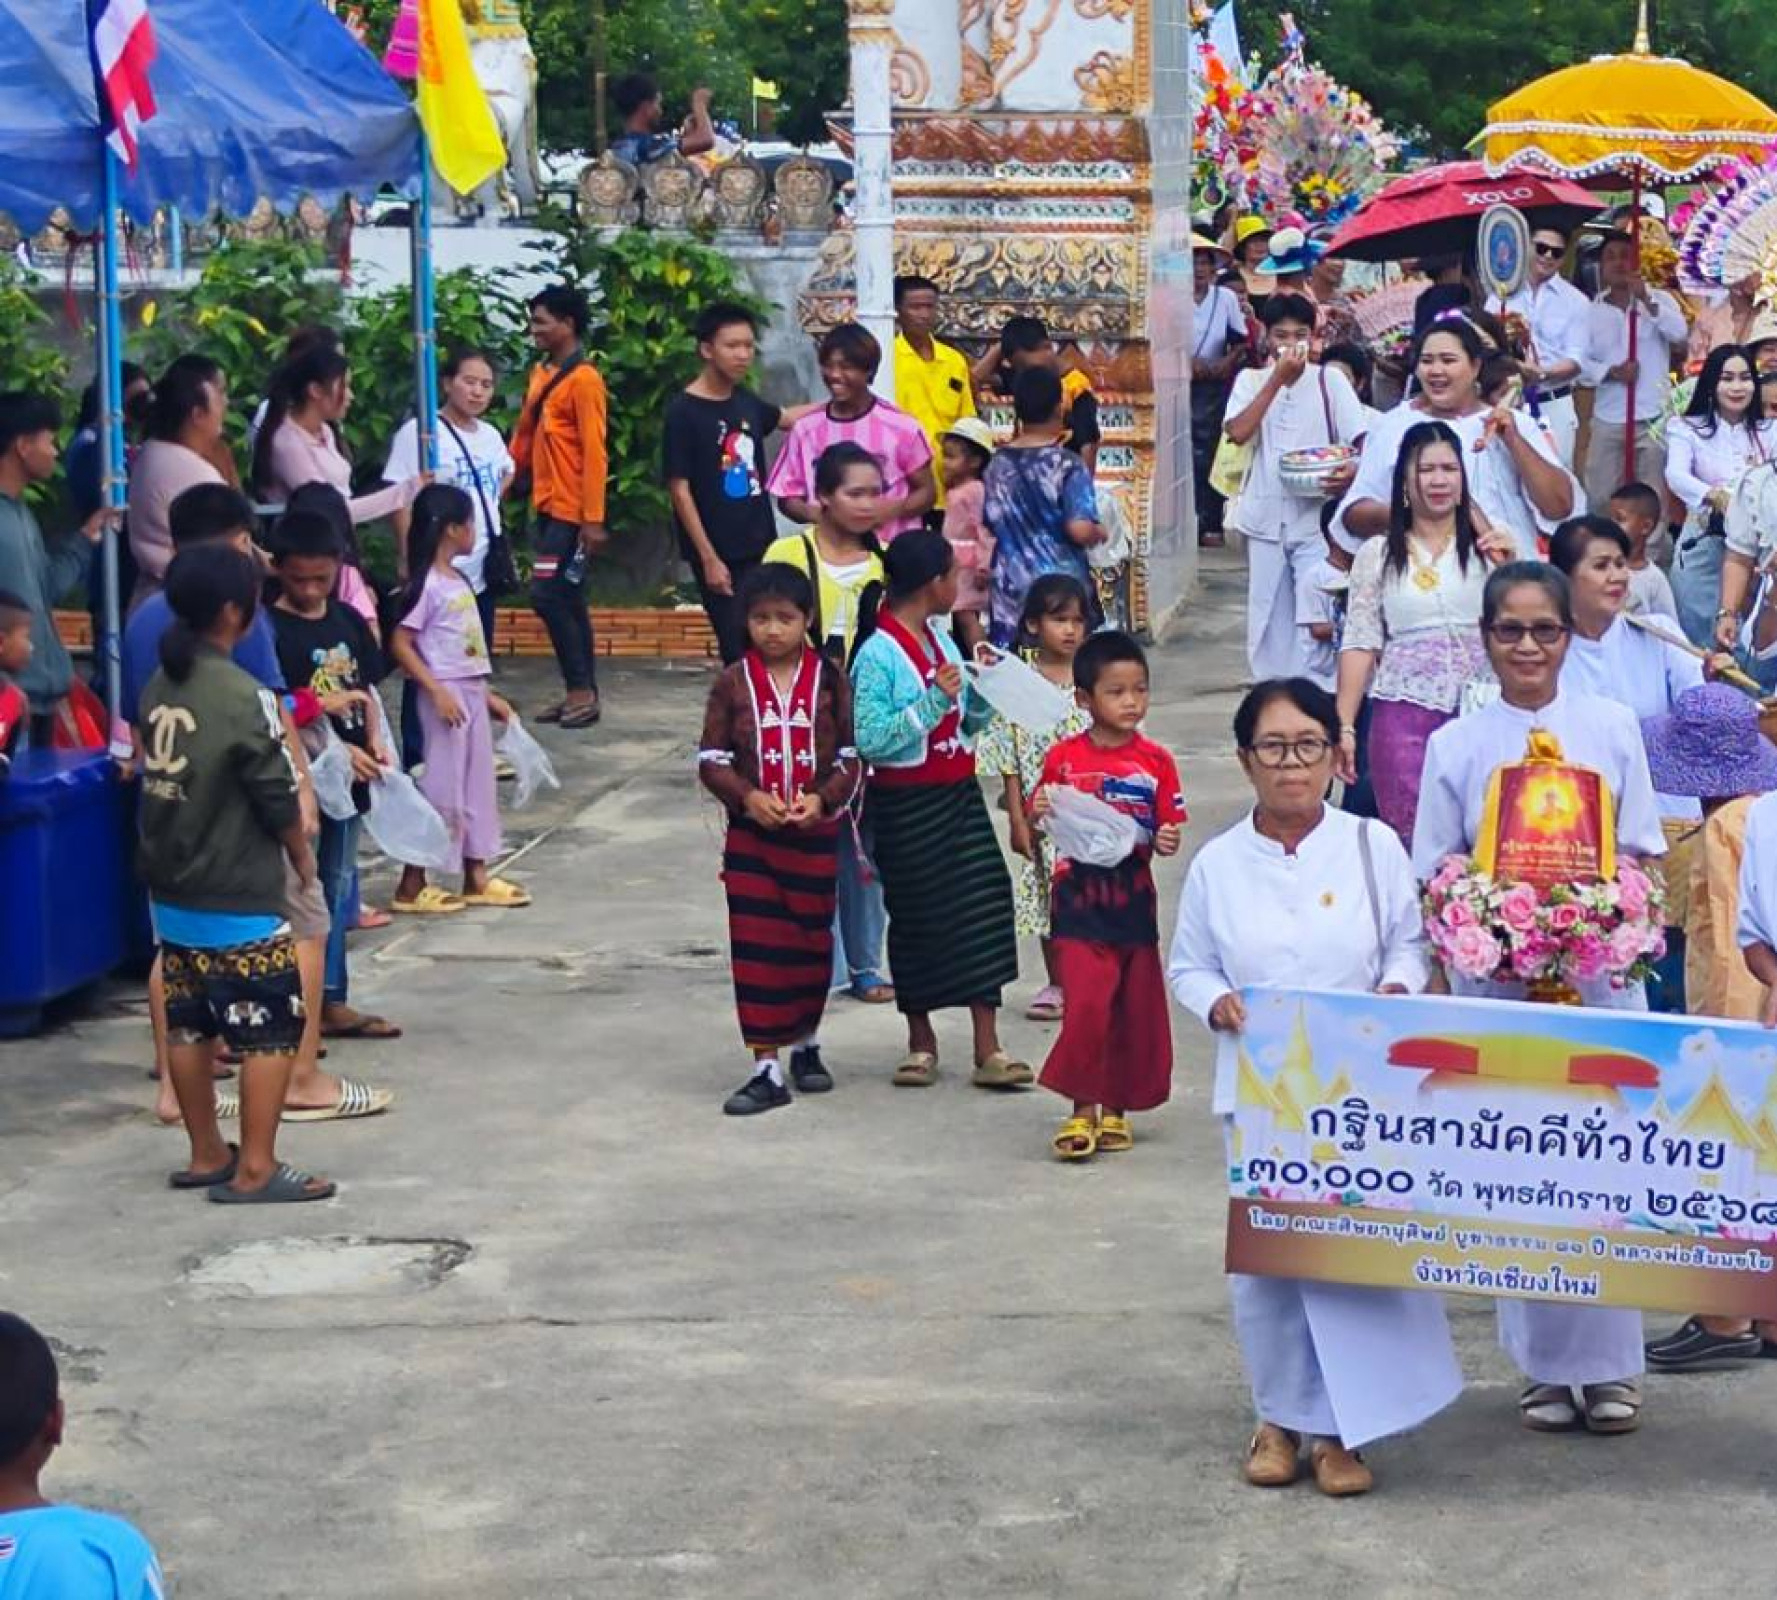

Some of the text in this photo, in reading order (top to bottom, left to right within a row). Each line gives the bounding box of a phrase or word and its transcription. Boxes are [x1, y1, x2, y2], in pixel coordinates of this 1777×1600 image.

[1462, 187, 1534, 205] XOLO
[1310, 1097, 1726, 1170] กฐินสามัคคีทั่วไทย
[1247, 1157, 1414, 1193] ๓๐,๐๐๐
[1427, 1168, 1463, 1198] วัด
[1473, 1178, 1632, 1213] พุทธศักราช
[1251, 1208, 1287, 1228] โดย
[1592, 1237, 1605, 1256] ปี
[1415, 1258, 1597, 1297] จังหวัดเชียงใหม่
